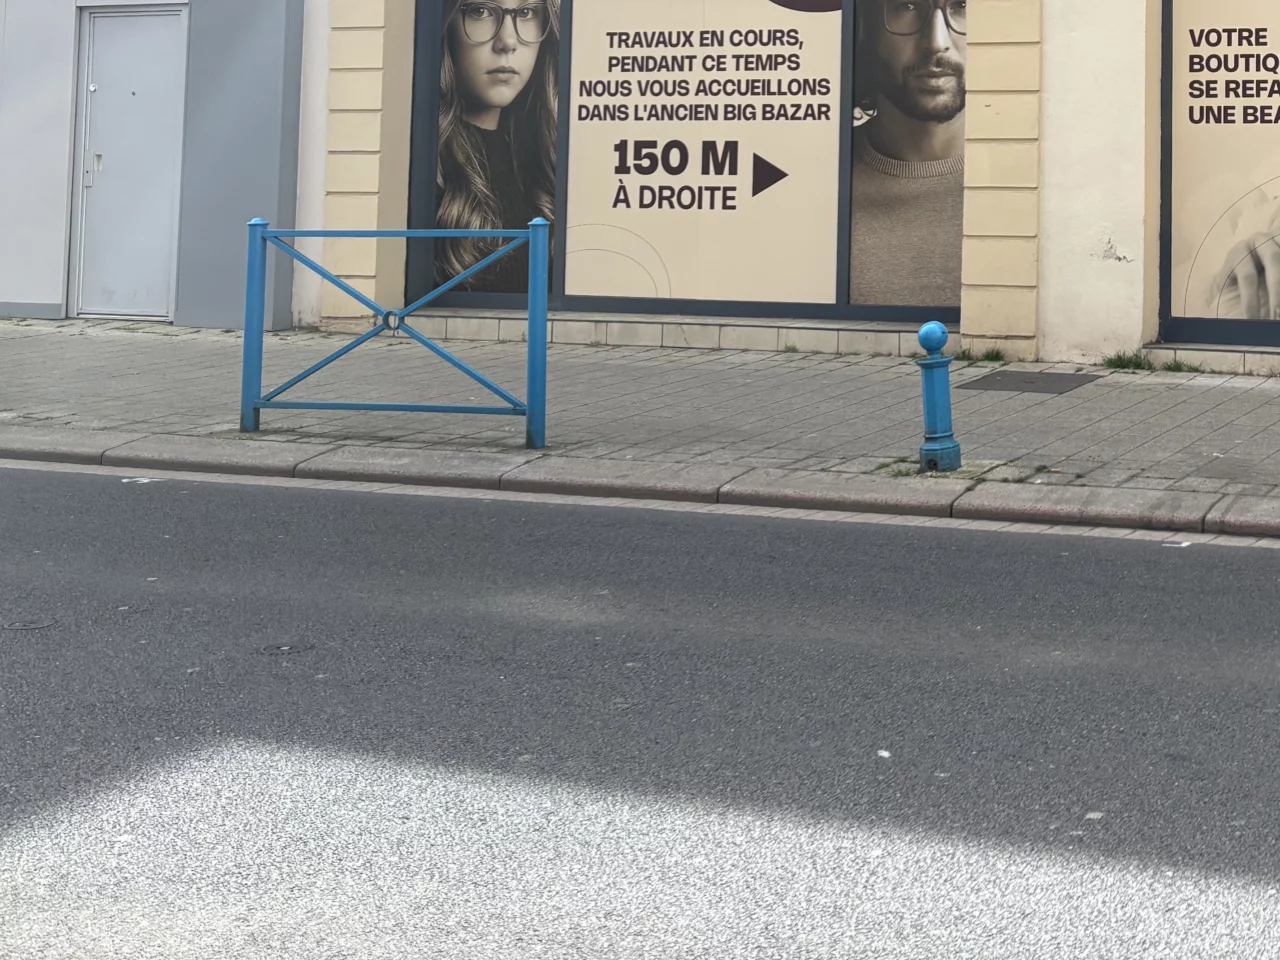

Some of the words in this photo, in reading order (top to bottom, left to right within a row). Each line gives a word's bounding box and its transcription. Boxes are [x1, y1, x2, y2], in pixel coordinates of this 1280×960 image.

[606, 31, 694, 48] TRAVAUX
[699, 30, 724, 47] EN
[729, 29, 803, 49] COURS,
[1189, 28, 1268, 47] VOTRE
[608, 55, 696, 72] PENDANT
[702, 54, 727, 72] CE
[732, 54, 800, 71] TEMPS
[579, 80, 632, 97] NOUS
[637, 80, 690, 97] VOUS
[695, 79, 830, 96] ACCUEILLONS
[1188, 80, 1218, 98] SE
[578, 105, 629, 121] DANS
[634, 104, 719, 121] L'ANCIEN
[723, 104, 756, 121] BIG
[761, 104, 831, 120] BAZAR
[1188, 105, 1236, 124] UNE
[612, 139, 689, 175] 150
[701, 141, 739, 175] M
[612, 179, 631, 209] À
[639, 186, 737, 210] DROITE
